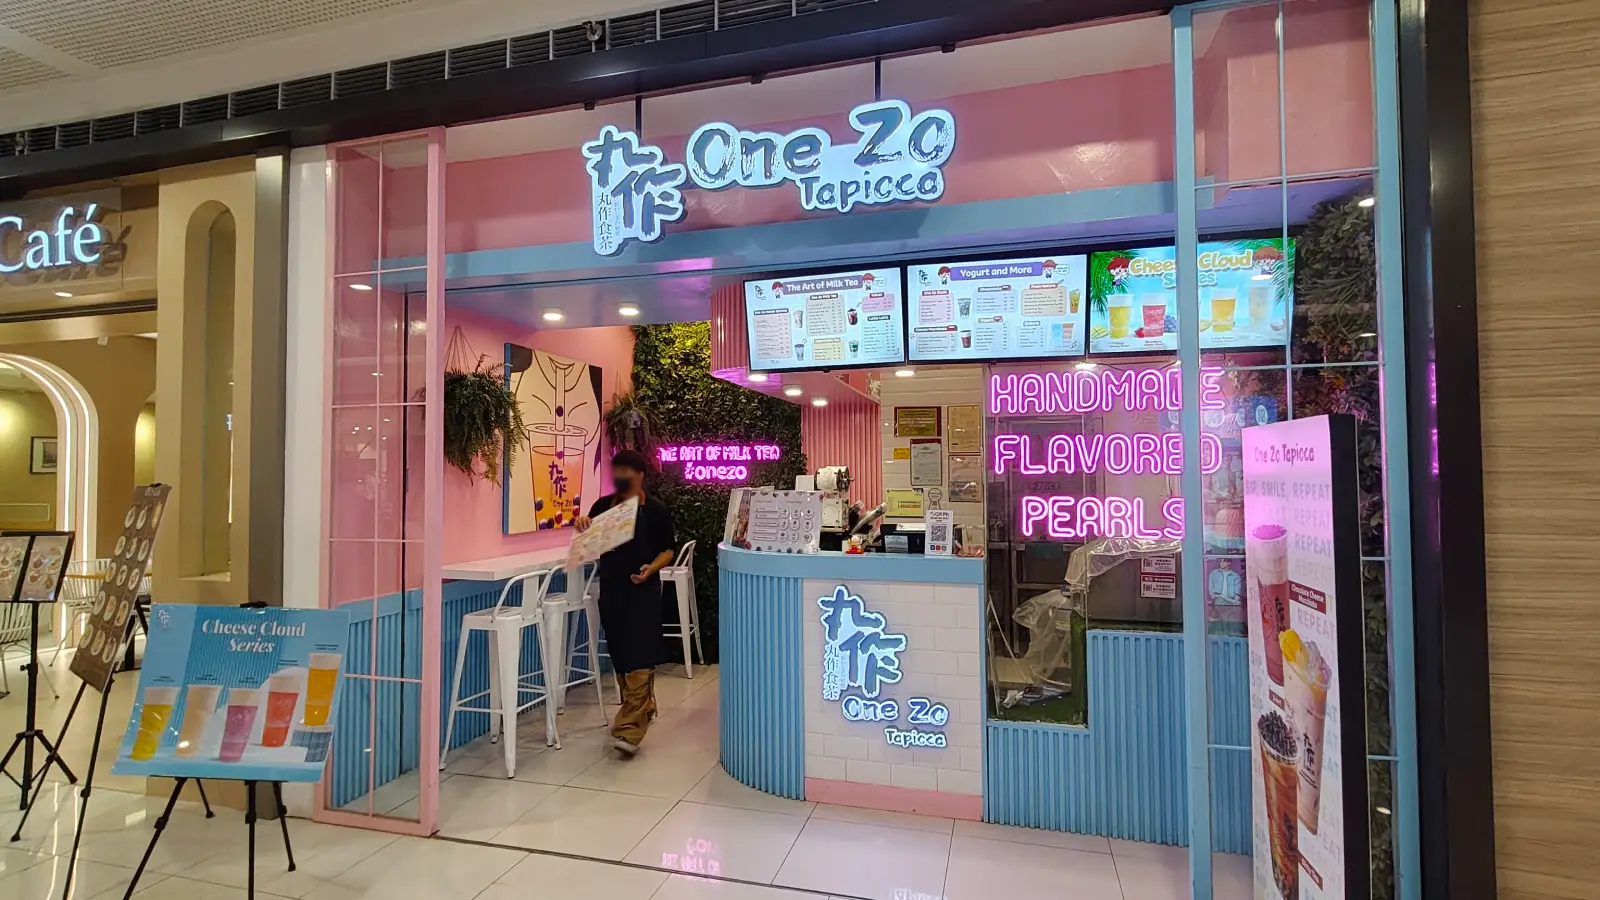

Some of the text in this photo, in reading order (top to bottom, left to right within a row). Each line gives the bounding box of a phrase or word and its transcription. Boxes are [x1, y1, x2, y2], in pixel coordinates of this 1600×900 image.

[690, 106, 951, 183] One Zo
[587, 130, 682, 237] 丸作
[0, 203, 100, 272] Café
[960, 266, 1032, 279] Yogurt and More
[1129, 249, 1253, 276] Chee Cloud
[786, 279, 858, 292] The Art of Milk Tea
[1163, 271, 1216, 287] Ses
[991, 367, 1226, 414] HANDMADE
[680, 446, 703, 461] ART
[706, 446, 722, 461] OF
[723, 446, 752, 461] MILK
[754, 445, 780, 461] TEA
[994, 433, 1223, 475] FLAVORED
[1261, 480, 1289, 501] SMILE,
[1292, 481, 1331, 501] REPEAT
[1022, 496, 1185, 540] PEARLS
[1294, 533, 1331, 559] REPEAT
[202, 619, 307, 637] Cheese Cloud
[1298, 607, 1335, 640] REPEAT
[227, 637, 275, 653] Series
[819, 588, 904, 696] 丸作
[842, 697, 949, 725] One Zo
